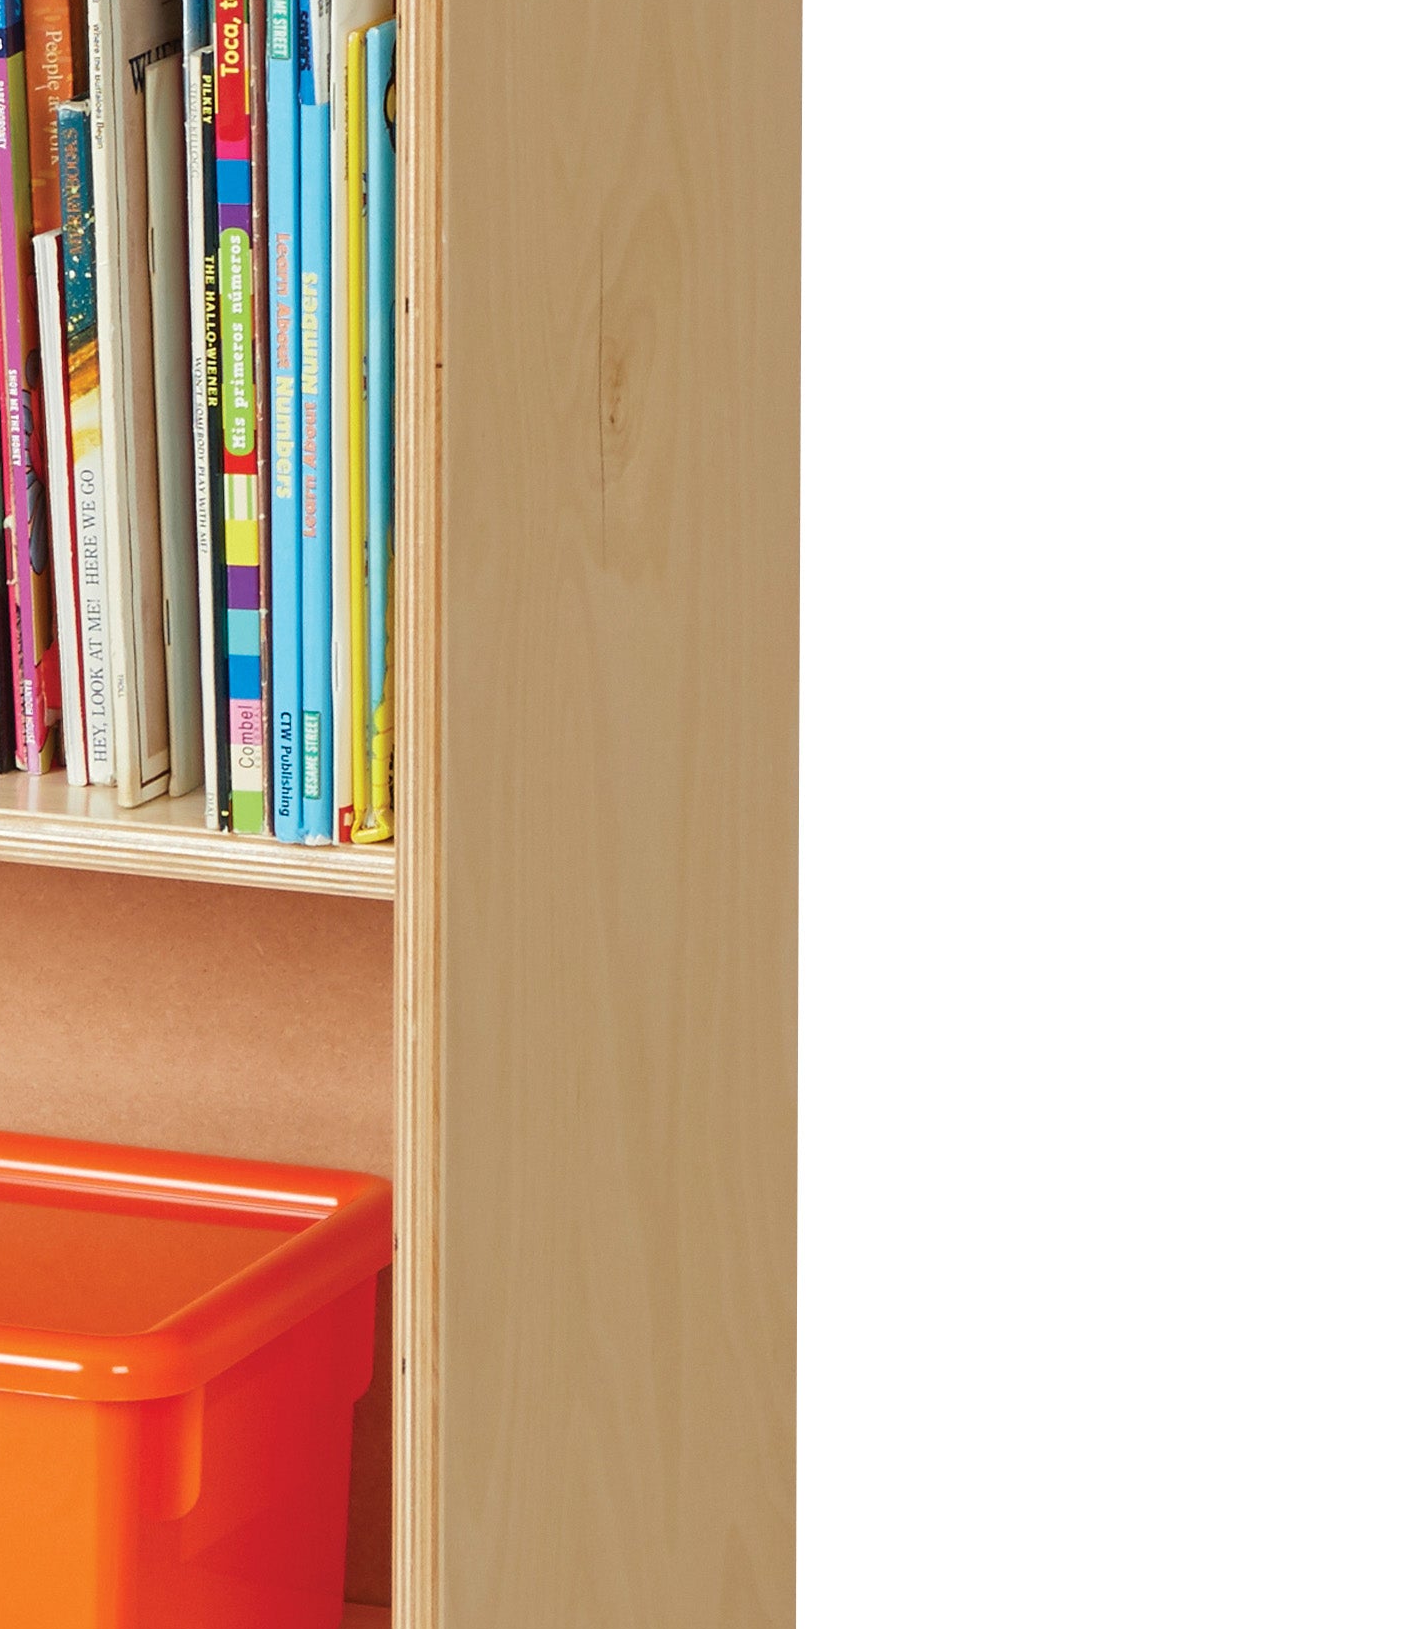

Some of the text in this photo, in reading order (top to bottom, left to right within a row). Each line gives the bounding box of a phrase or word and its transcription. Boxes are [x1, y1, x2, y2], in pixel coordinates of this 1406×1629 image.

[39, 30, 63, 90] People
[220, 15, 243, 78] Toca,
[84, 536, 106, 716] LOOK HERE
[232, 417, 255, 769] Mis Combel
[274, 375, 294, 817] Numbers Publishing
